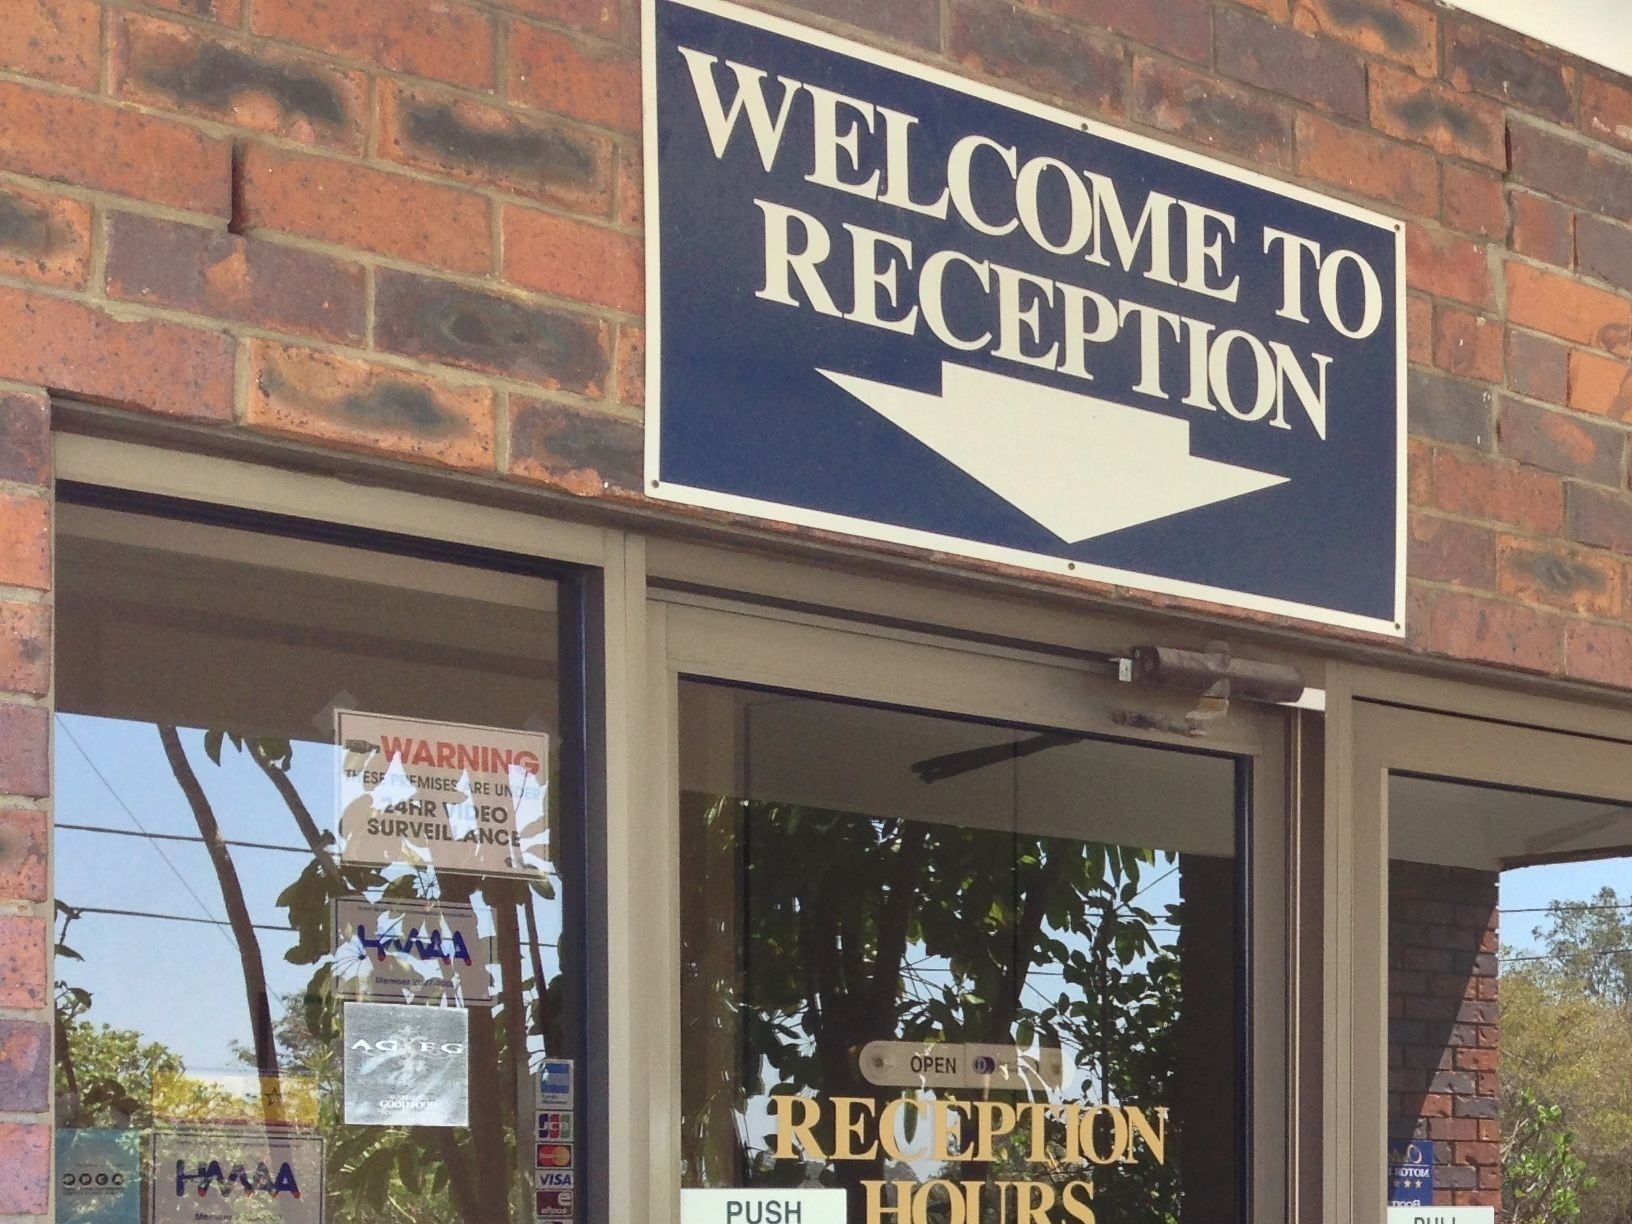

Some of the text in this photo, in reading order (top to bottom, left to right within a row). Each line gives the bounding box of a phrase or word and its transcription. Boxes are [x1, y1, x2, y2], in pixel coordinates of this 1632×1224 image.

[678, 45, 1382, 340] WELCOME TO
[754, 199, 1332, 440] RECEPTION
[380, 735, 540, 775] WARNING
[367, 818, 521, 847] SURVEILANCE
[910, 1055, 957, 1074] OPEN
[770, 1094, 1169, 1166] RECEPTION
[540, 1173, 572, 1186] VISA
